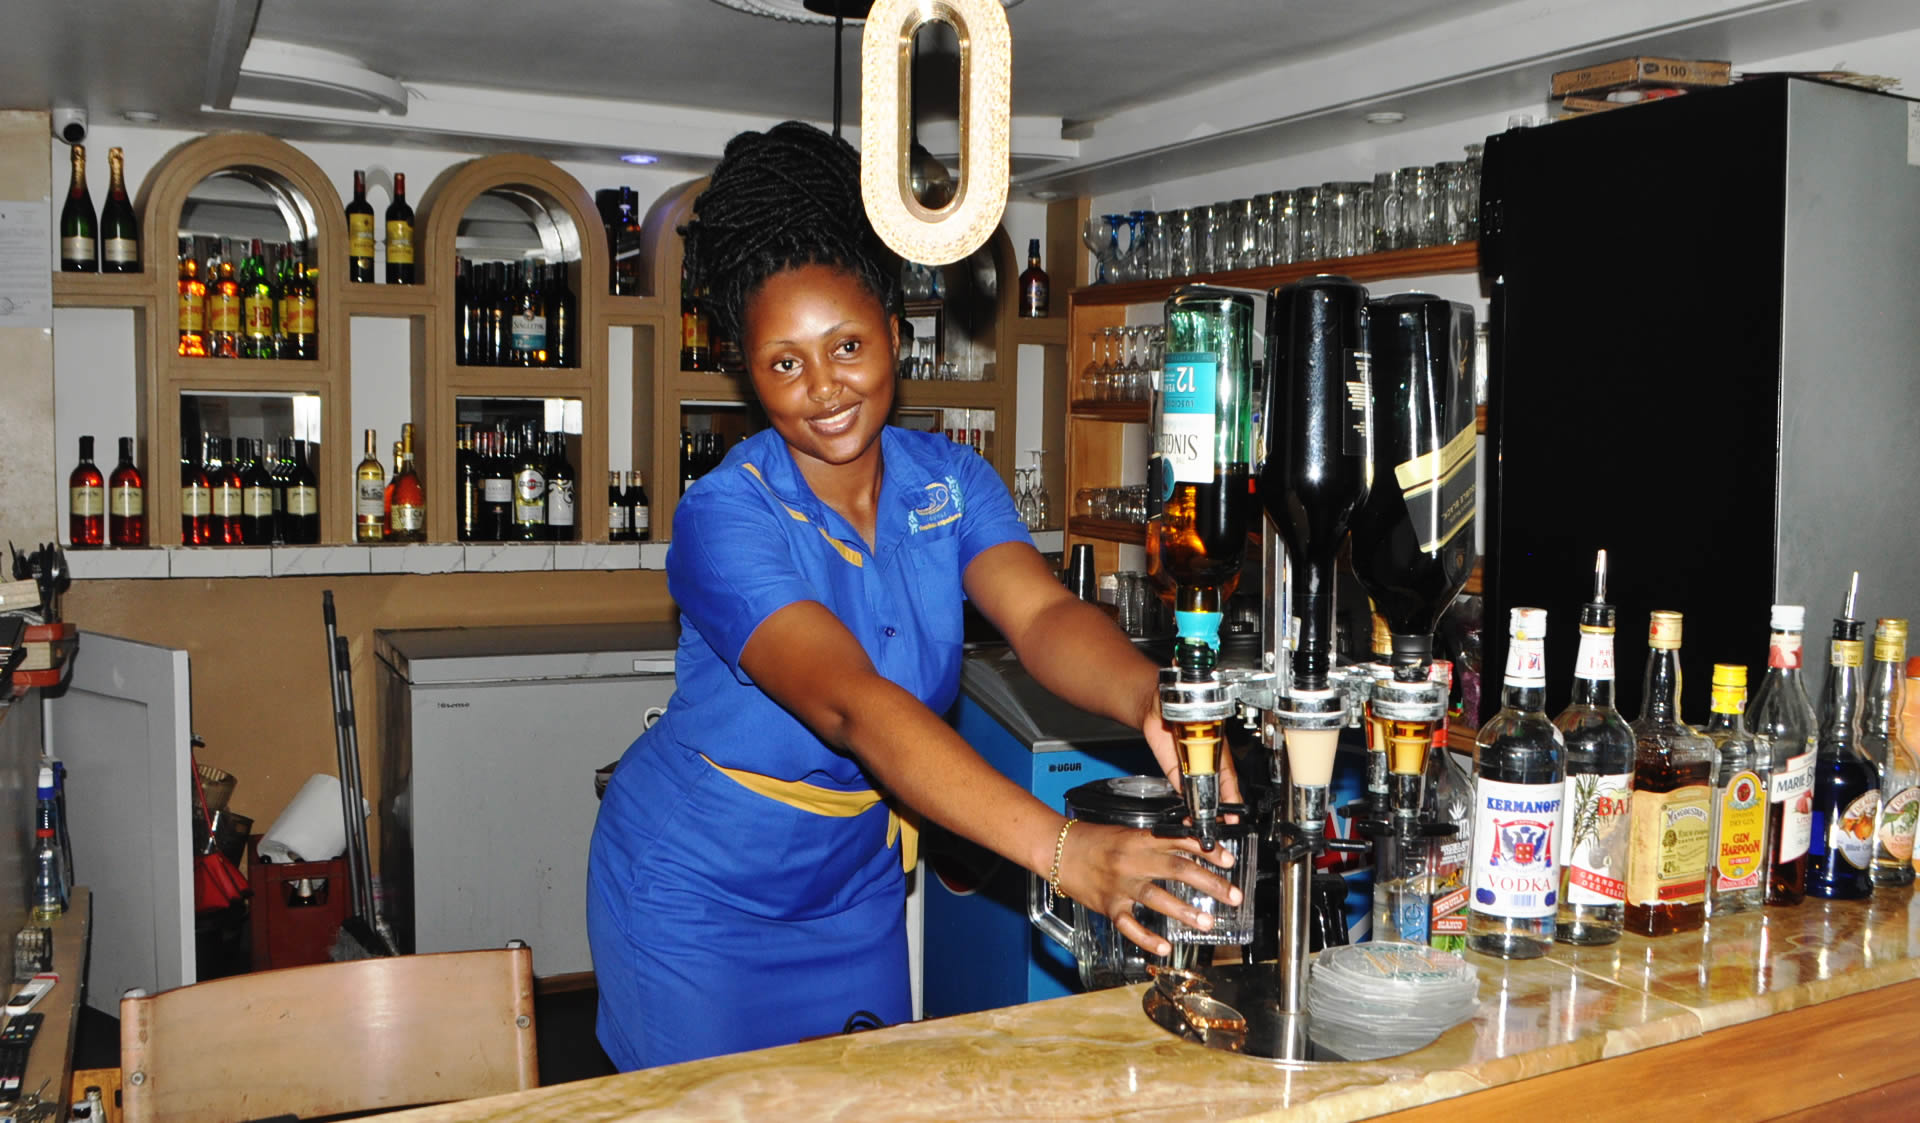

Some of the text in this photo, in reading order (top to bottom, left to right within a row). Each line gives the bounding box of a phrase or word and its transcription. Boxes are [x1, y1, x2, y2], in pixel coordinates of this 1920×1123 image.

[1664, 65, 1686, 77] 100
[1177, 366, 1197, 393] 12
[1776, 776, 1806, 794] MARIE
[1487, 796, 1561, 813] KERMANOFF
[1733, 832, 1750, 844] GIN
[1721, 840, 1760, 857] HARPOON
[1488, 874, 1551, 892] VODKA
[1579, 871, 1614, 888] GRAND
